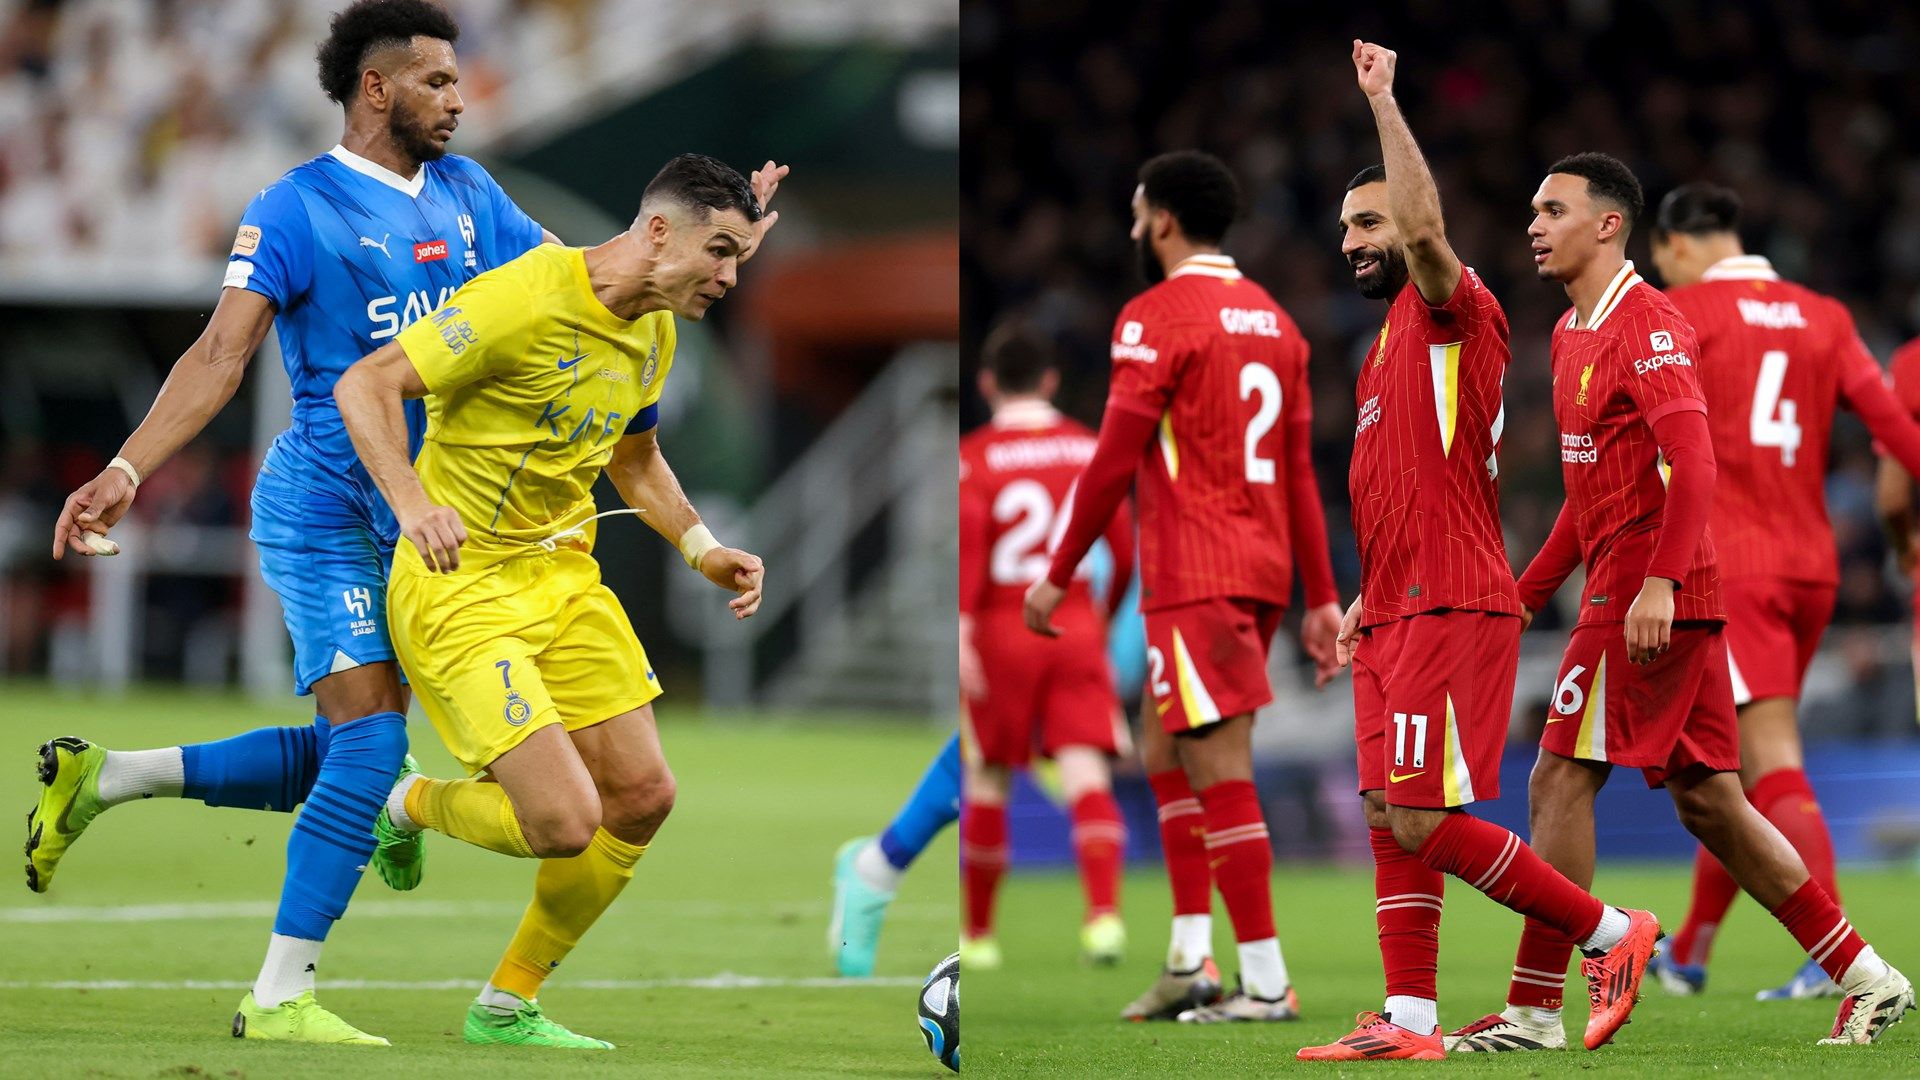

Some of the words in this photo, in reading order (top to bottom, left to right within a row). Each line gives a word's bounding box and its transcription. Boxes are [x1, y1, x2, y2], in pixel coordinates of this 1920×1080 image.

[416, 244, 446, 261] jahez
[367, 286, 458, 340] SAV
[1219, 307, 1281, 338] GOMEZ
[535, 401, 633, 447] KAF
[1239, 361, 1283, 486] 2
[1750, 350, 1802, 468] 4
[495, 660, 512, 689] 7
[1147, 645, 1172, 698] 2
[1550, 664, 1587, 715] 6
[1393, 712, 1428, 769] 11
